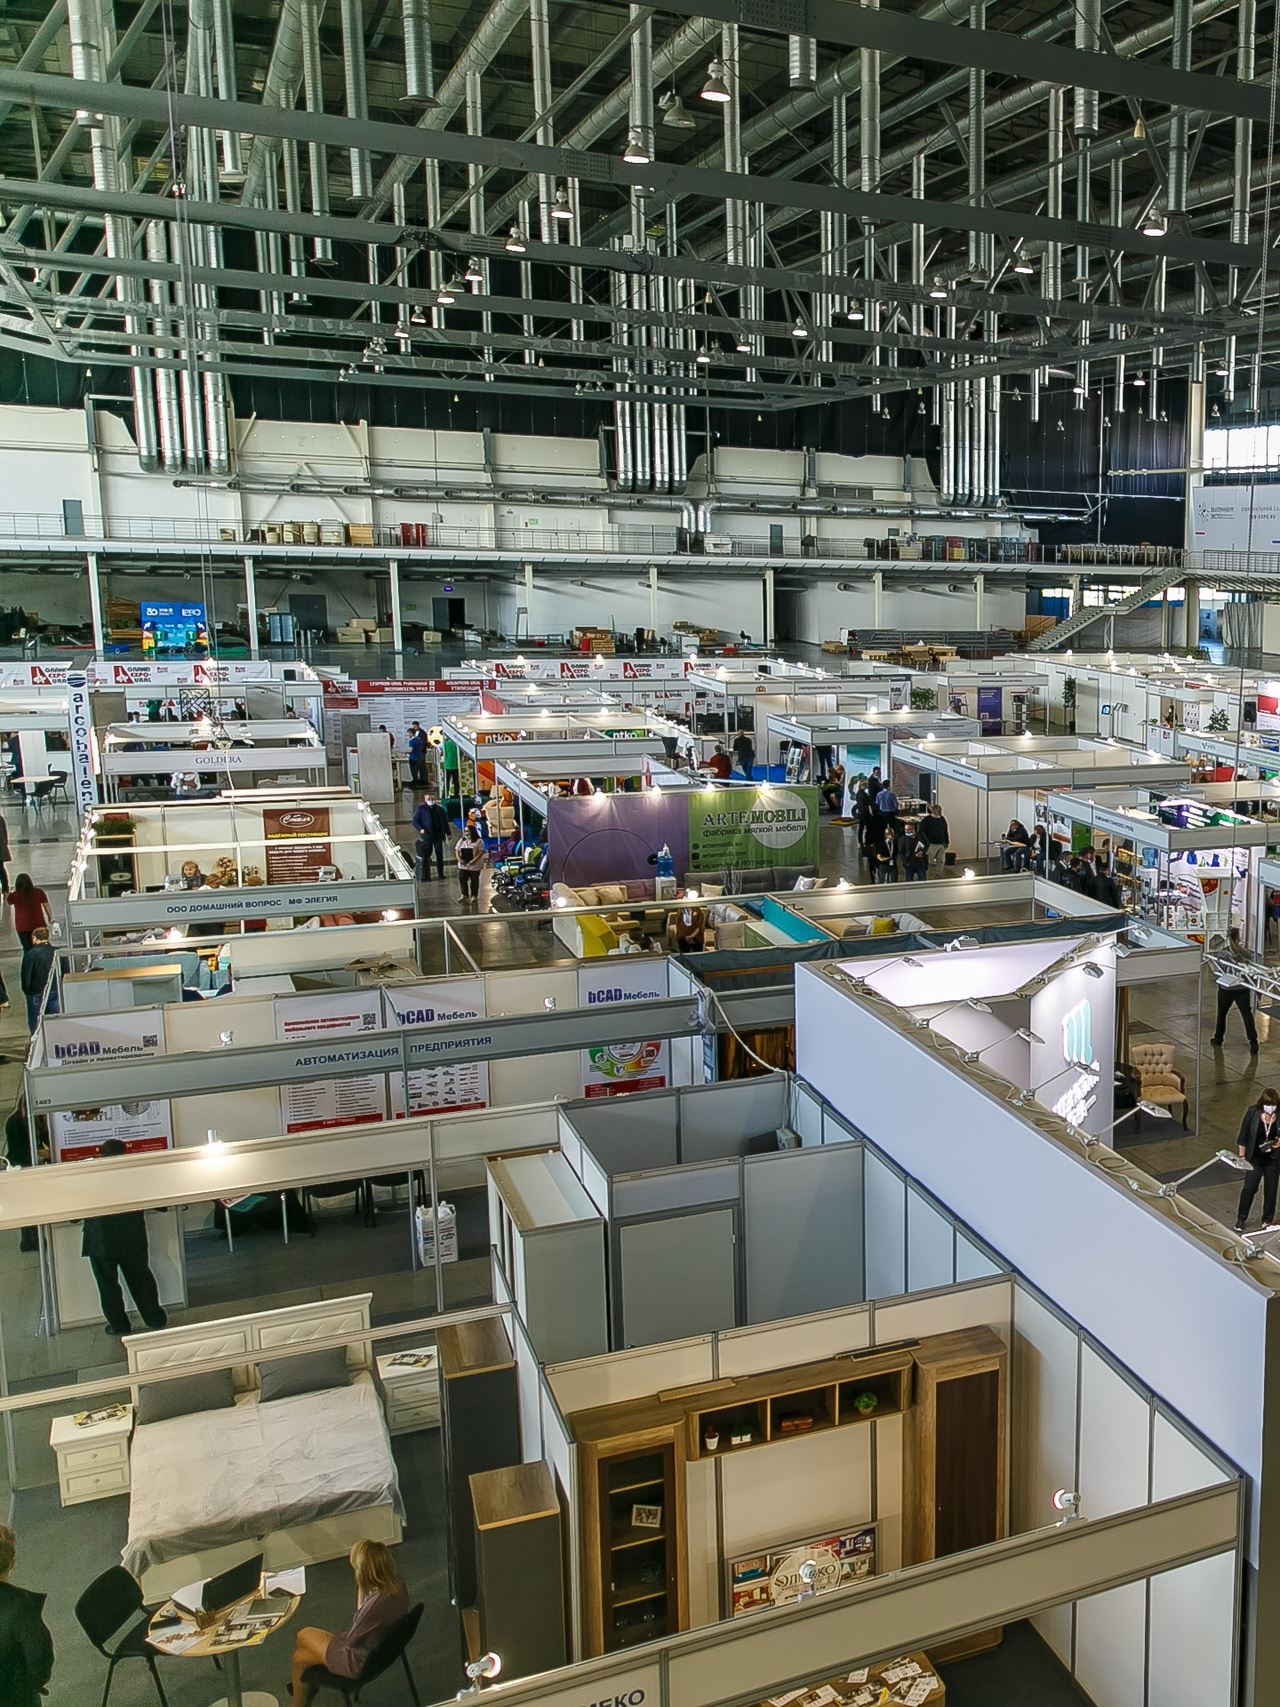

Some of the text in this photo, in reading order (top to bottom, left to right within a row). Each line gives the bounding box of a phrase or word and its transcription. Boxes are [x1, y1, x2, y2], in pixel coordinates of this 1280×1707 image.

[702, 823, 807, 838] фабрика мягкой мебели
[166, 895, 338, 914] ООО ДОМАШНИЙ ВОПРОС МФ ЭЛЕГИЯ
[623, 991, 661, 1001] Мебель
[437, 1011, 478, 1021] Мебель
[54, 1041, 144, 1059] bCAD Мебель
[96, 1052, 155, 1062] проектирование
[295, 1035, 492, 1067] АВТОМАТИЗАЦИЯ ПРЕДПРИЯТИЯ
